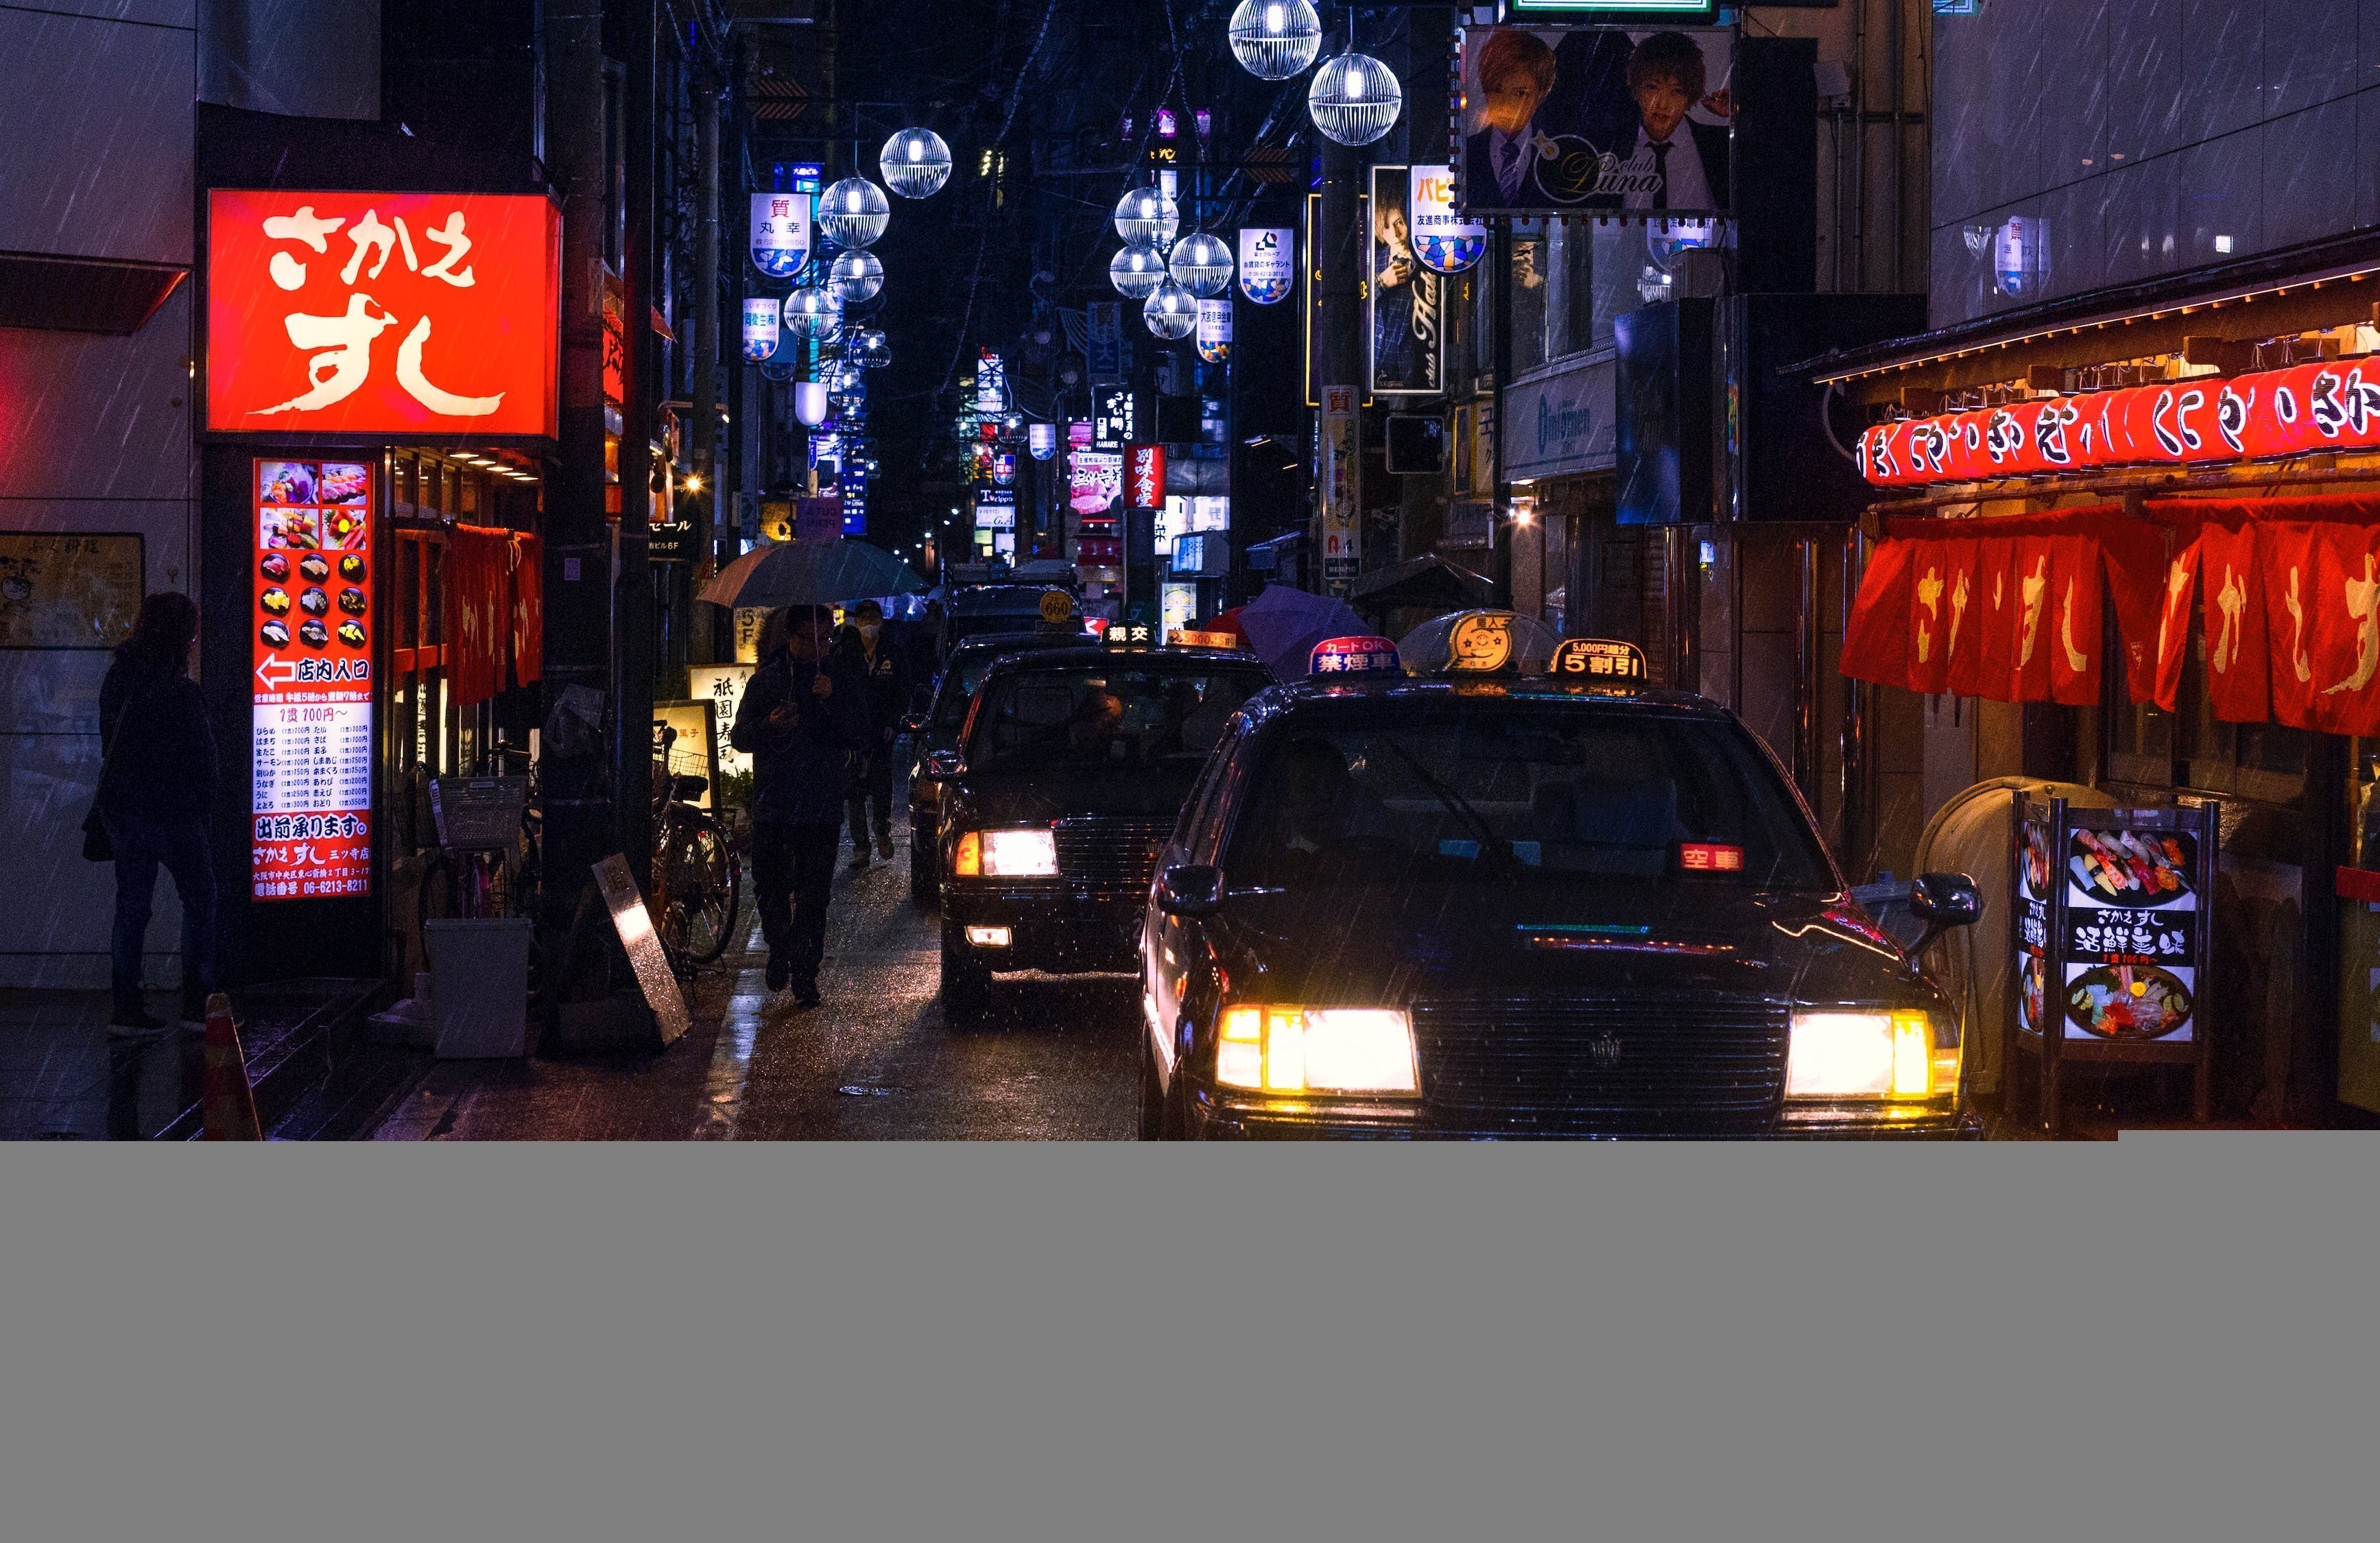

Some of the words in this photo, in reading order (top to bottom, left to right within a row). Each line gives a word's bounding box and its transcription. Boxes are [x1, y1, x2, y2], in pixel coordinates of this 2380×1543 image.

[1418, 178, 1455, 202] パピ
[772, 200, 789, 217] 質
[263, 206, 476, 291] さかえ
[244, 292, 506, 417] すし
[1109, 627, 1148, 642] 親交
[298, 658, 370, 682] 店内入口
[1318, 654, 1394, 672] 禁煙車
[1564, 655, 1638, 675] 5割引
[257, 758, 281, 767] サーモン
[257, 780, 274, 788] うなぎ
[256, 813, 367, 841] 出前承ります。
[329, 847, 369, 860] 三ツ寺店
[1683, 848, 1739, 870] 空車
[254, 881, 298, 896] 電話番号
[304, 879, 368, 894] 06-6213-8211
[2075, 926, 2185, 955] 活鮮美味
